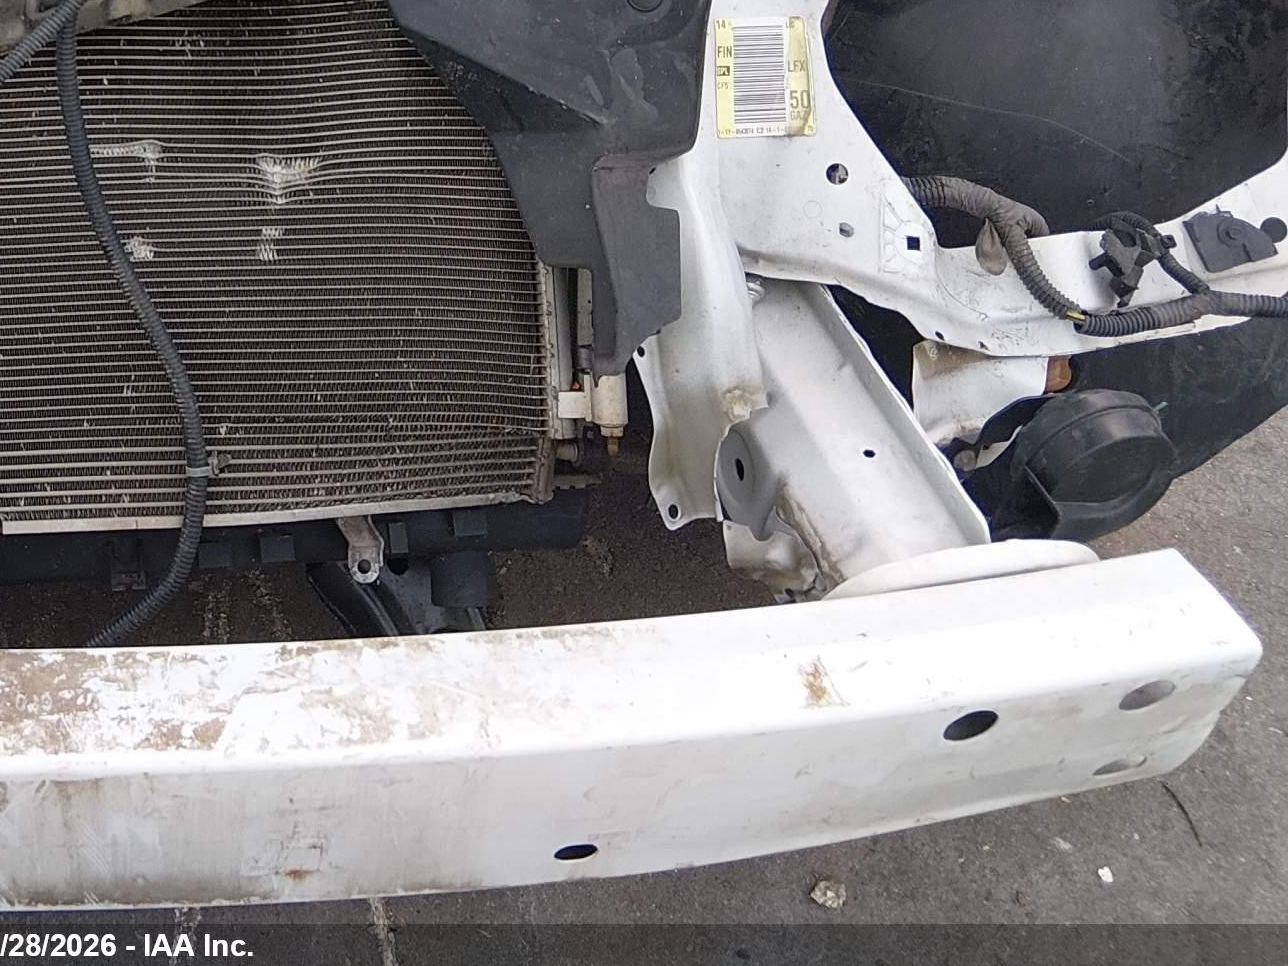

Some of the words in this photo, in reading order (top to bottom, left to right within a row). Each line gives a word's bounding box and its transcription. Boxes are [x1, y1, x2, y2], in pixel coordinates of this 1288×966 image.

[717, 45, 733, 58] FIN
[787, 59, 806, 73] LFX
[789, 89, 810, 109] 50
